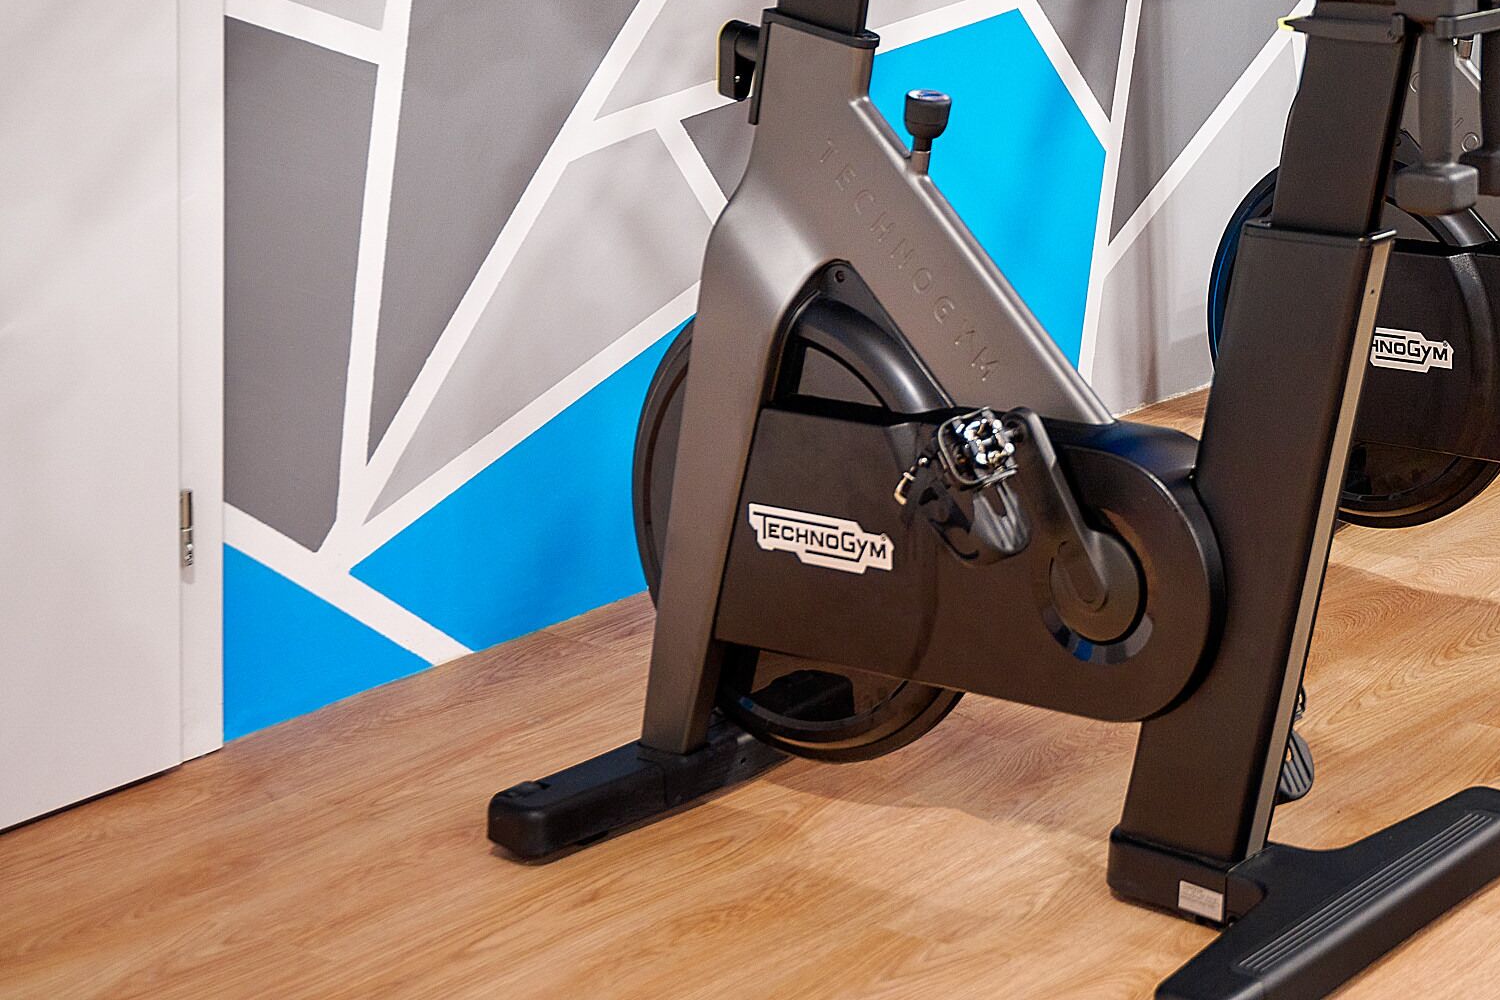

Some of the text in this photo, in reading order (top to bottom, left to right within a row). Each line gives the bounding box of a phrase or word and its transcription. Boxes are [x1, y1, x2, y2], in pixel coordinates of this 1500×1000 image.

[820, 139, 998, 381] TECHNOGYM
[1372, 333, 1449, 365] HNOGYM
[753, 511, 887, 563] TECHNOGYM
